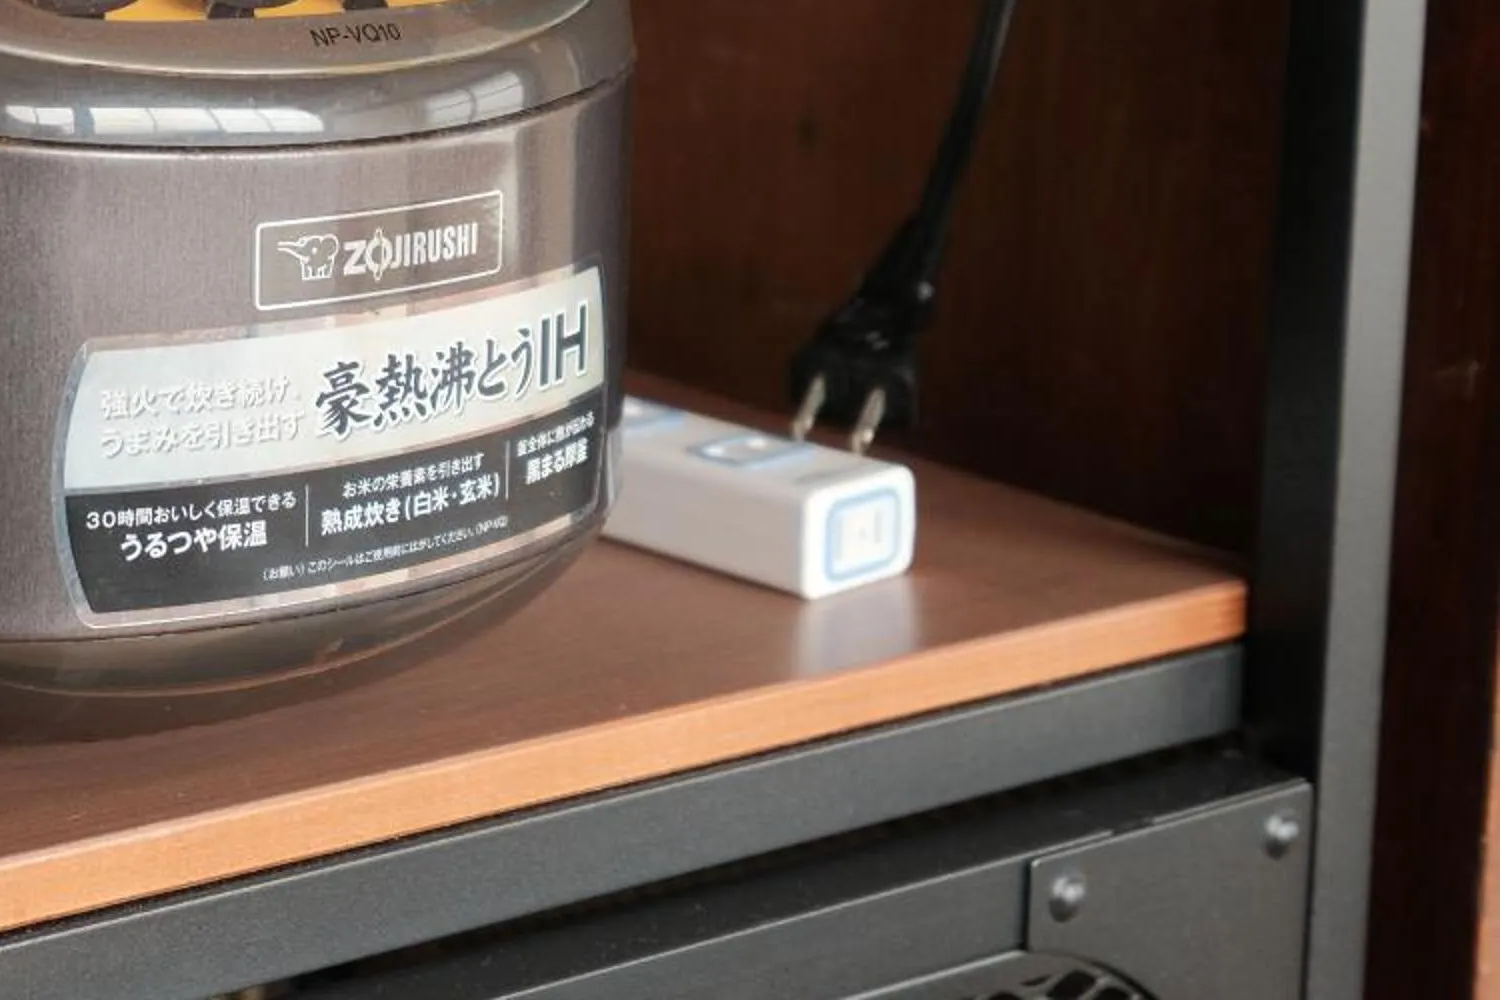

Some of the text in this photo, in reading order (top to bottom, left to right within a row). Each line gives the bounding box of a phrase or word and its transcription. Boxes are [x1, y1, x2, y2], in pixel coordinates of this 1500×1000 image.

[309, 23, 402, 47] NP-VQ10
[343, 222, 479, 283] ZOJIRUSHI
[101, 411, 305, 460] うまみを引き出す
[86, 490, 297, 530] 30時間おいしく保温できる
[120, 519, 268, 562] うるつや保温
